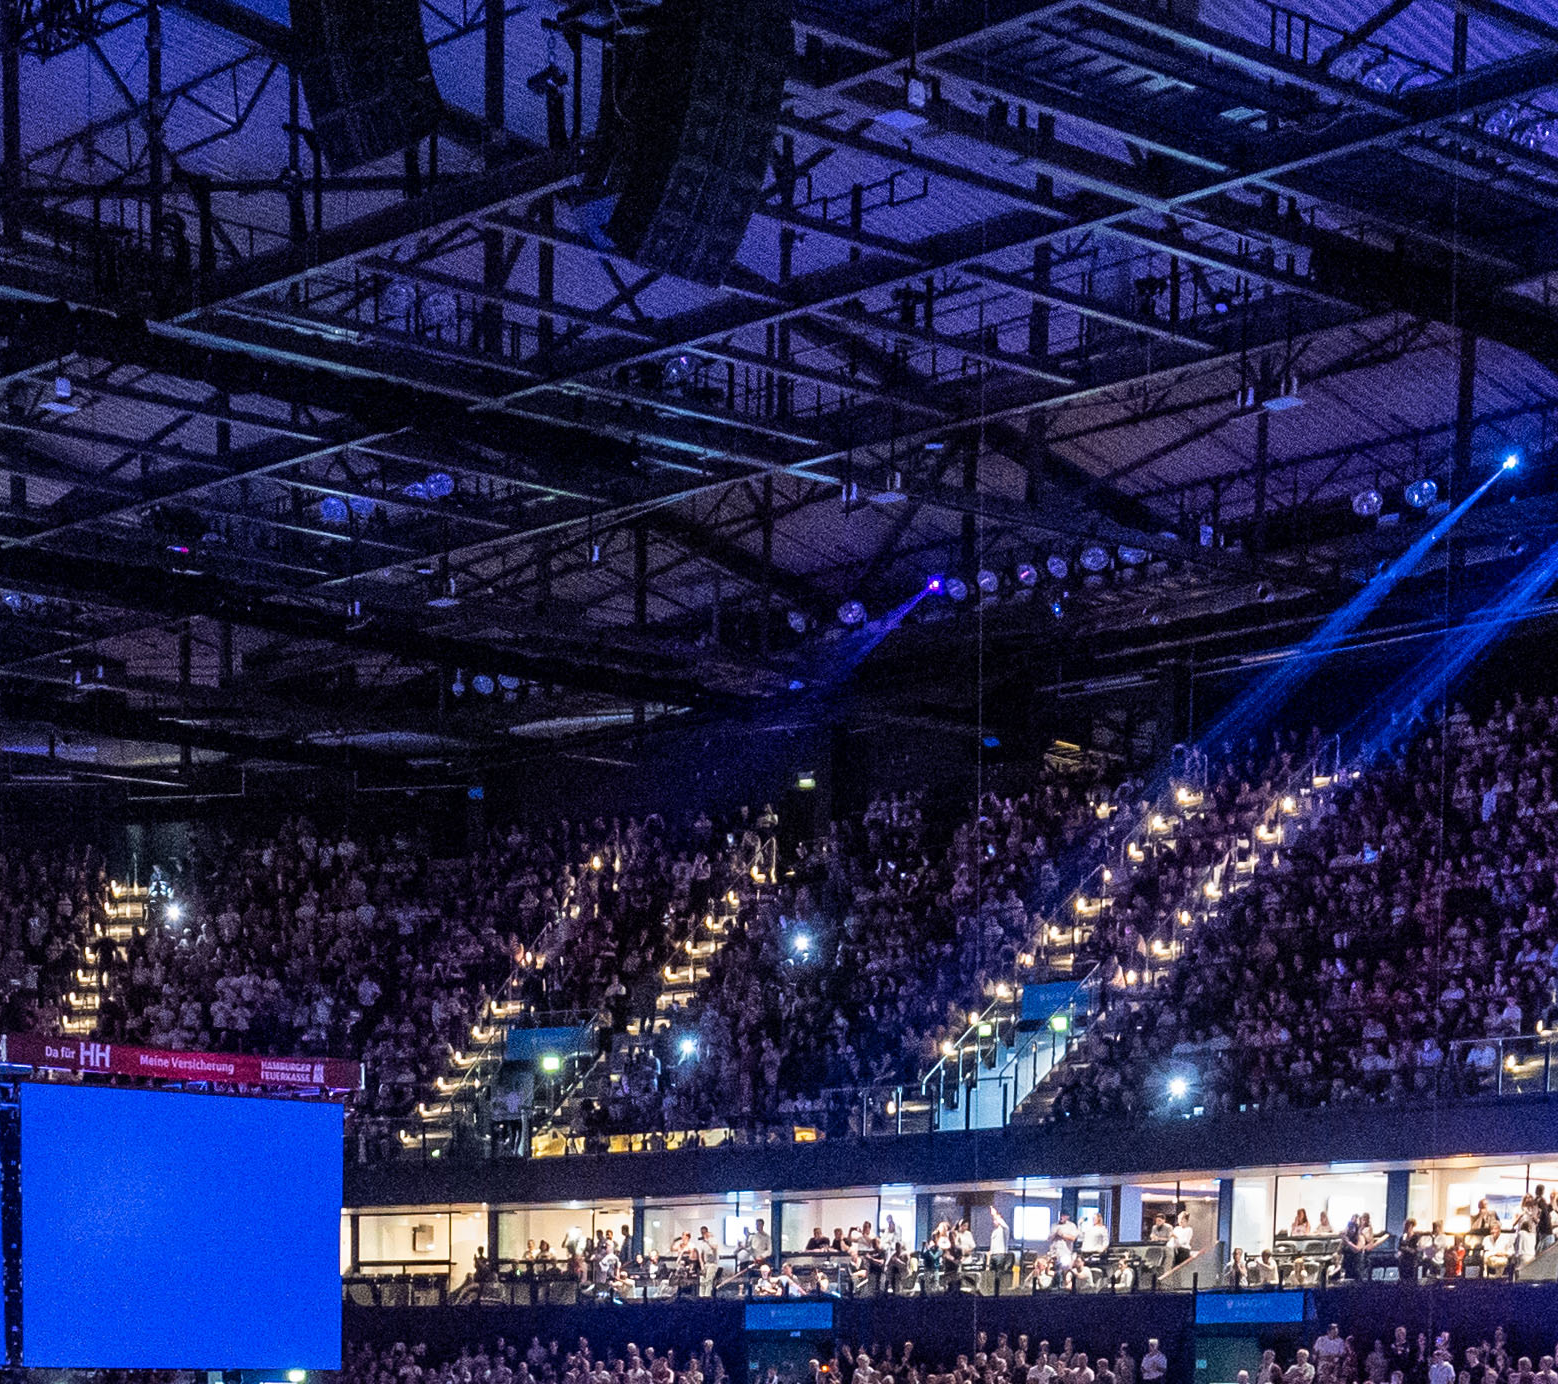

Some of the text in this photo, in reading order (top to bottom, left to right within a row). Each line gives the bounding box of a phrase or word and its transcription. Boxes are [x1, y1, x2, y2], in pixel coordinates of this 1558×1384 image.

[44, 1042, 111, 1068] Da für HH
[139, 1054, 235, 1076] Meine Versicherung
[260, 1060, 312, 1073] HAMBURGER
[260, 1070, 312, 1083] FEUERKASSE
